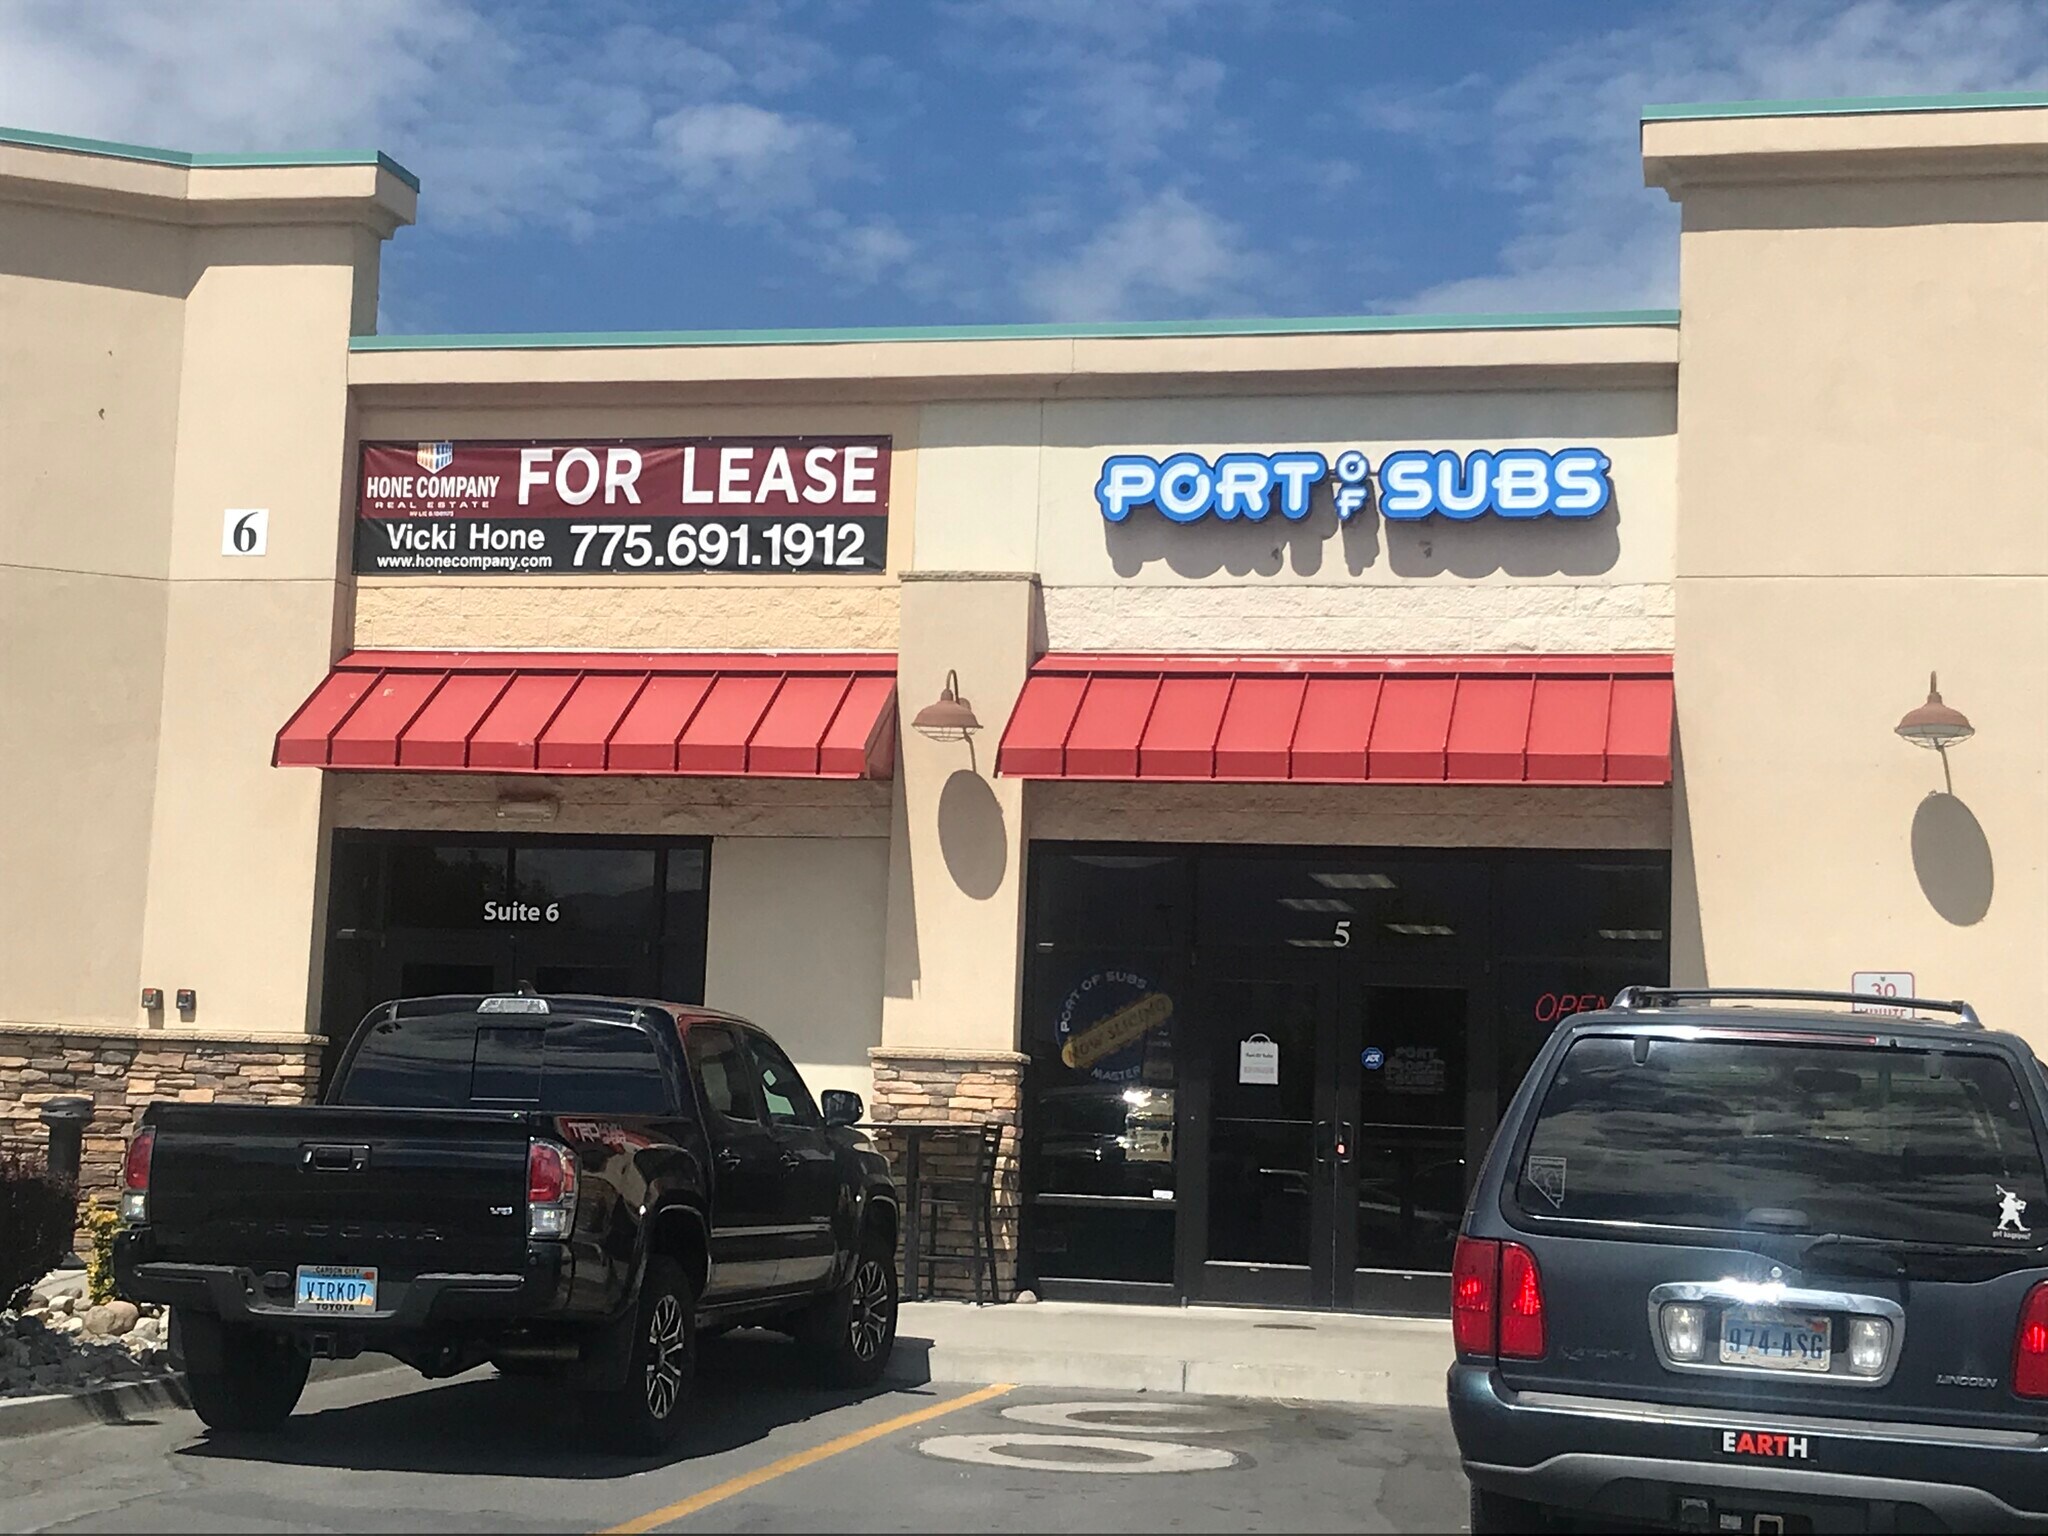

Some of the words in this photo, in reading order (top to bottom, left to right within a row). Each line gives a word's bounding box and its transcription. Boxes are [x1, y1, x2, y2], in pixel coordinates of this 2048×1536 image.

[366, 476, 414, 499] HONE
[416, 475, 501, 499] COMPANY
[517, 446, 643, 506] FOR
[681, 445, 878, 505] LEASE
[1098, 452, 1326, 523] PORT
[1335, 449, 1370, 521] OF
[1379, 448, 1612, 519] SUBS
[375, 501, 417, 509] REAL
[426, 501, 490, 509] ESTATE
[233, 511, 259, 552] 6
[386, 523, 456, 550] Vicki
[469, 523, 546, 550] Hone
[569, 523, 866, 567] 775.691.1912
[376, 554, 553, 571] www.honecompany.com
[483, 901, 541, 921] Suite
[545, 902, 560, 922] 6
[1333, 921, 1351, 947] 5
[1060, 988, 1080, 1033] PORT
[1081, 974, 1101, 991] OF
[1106, 971, 1148, 990] SUBS
[567, 1122, 600, 1142] TRD
[316, 1303, 355, 1311] TOYOTA
[1935, 1373, 1999, 1388] LINCOLN
[1723, 1430, 1808, 1459] EARTH
